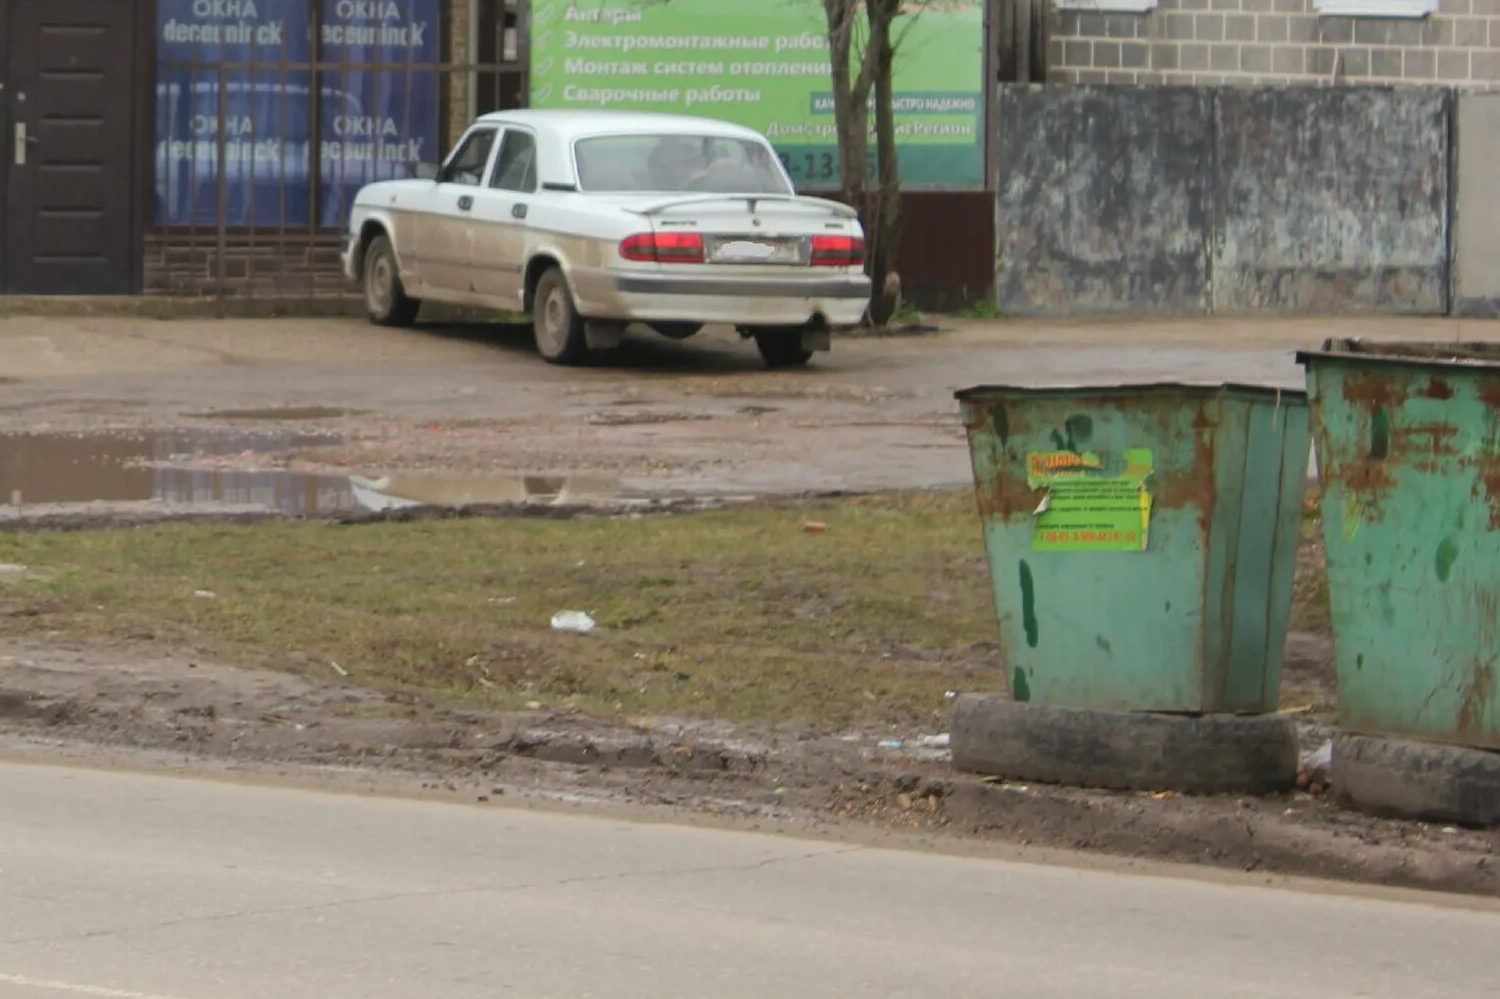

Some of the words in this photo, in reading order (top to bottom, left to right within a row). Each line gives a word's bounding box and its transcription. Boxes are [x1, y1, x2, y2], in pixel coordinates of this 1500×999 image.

[335, 0, 400, 20] ОКНА
[565, 30, 770, 53] Электромонтажные
[564, 57, 648, 76] Монтаж
[654, 59, 724, 76] систем
[730, 59, 834, 76] отоплени
[564, 83, 680, 106] Сварочные
[685, 82, 761, 107] работы
